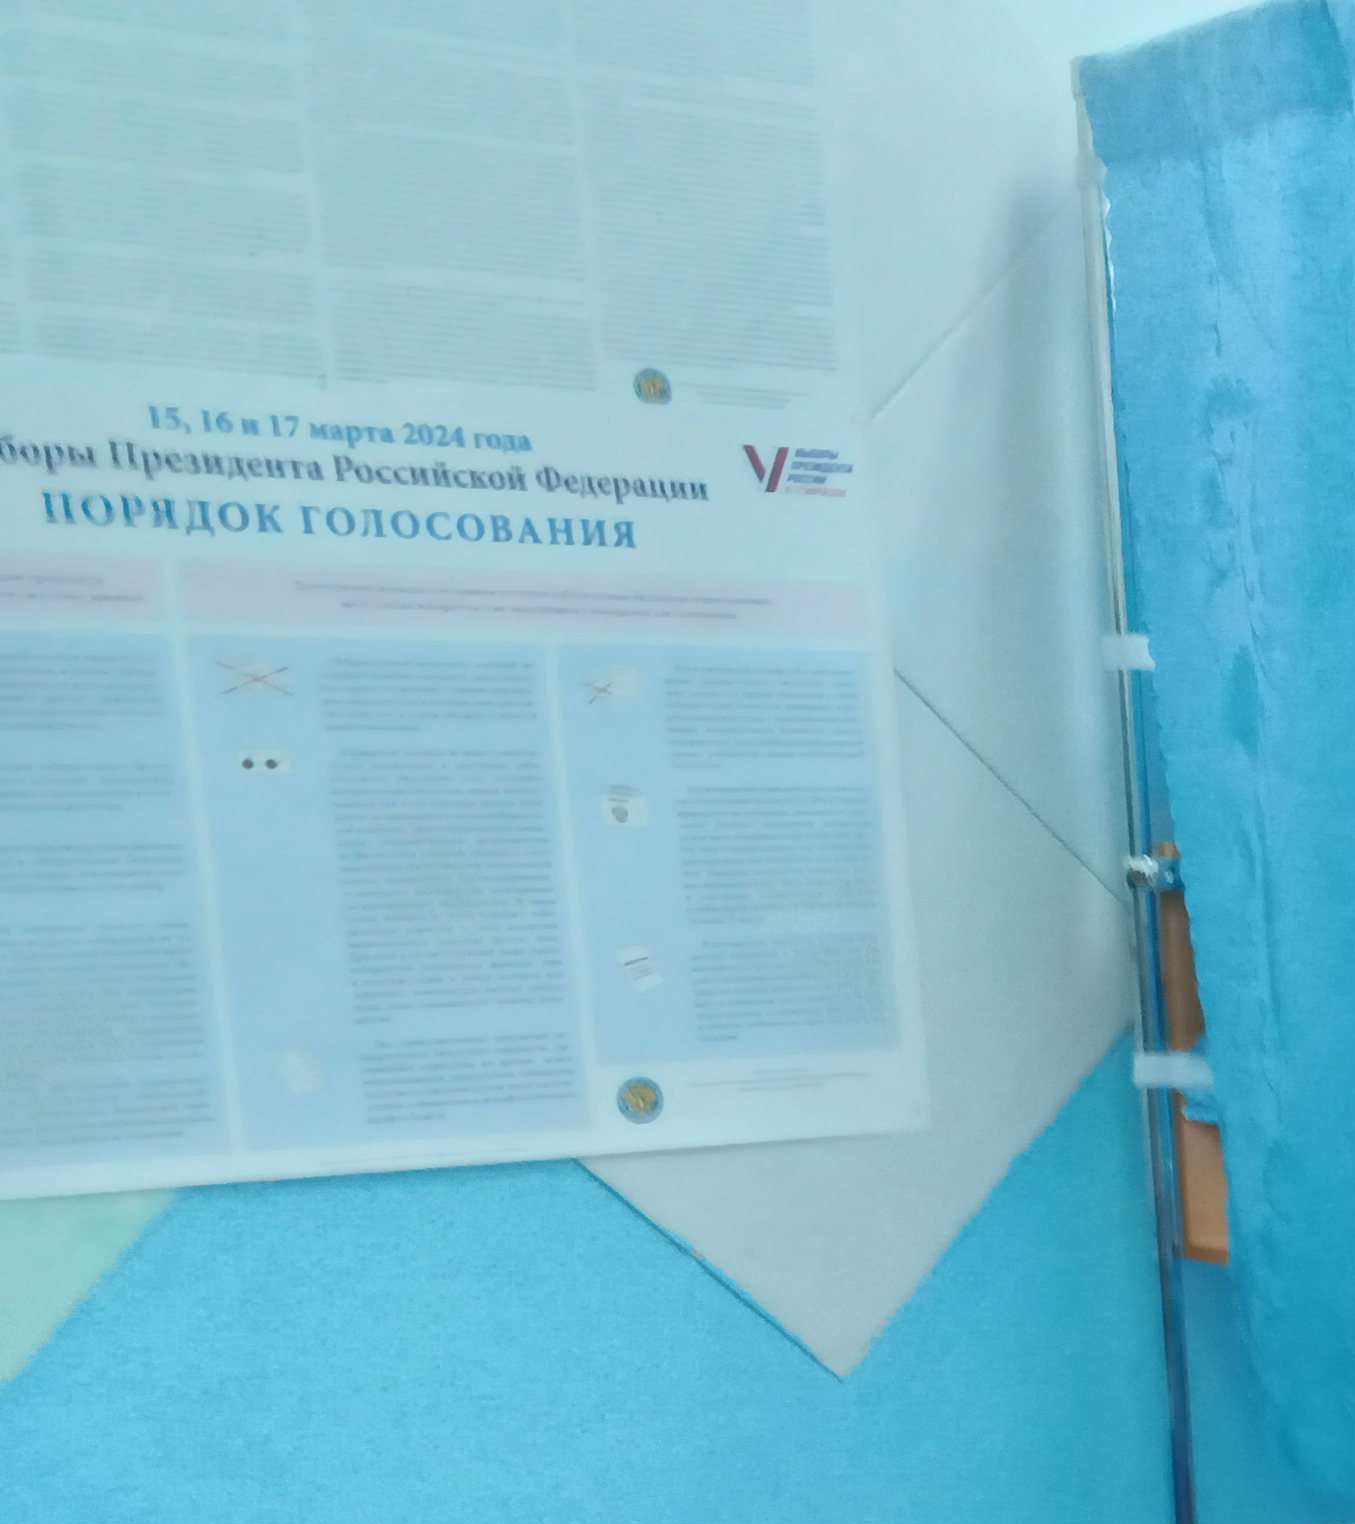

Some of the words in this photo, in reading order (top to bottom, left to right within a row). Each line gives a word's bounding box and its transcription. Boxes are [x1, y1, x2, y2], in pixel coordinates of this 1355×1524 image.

[148, 405, 192, 434] 15,
[201, 410, 234, 434] 16
[241, 418, 260, 436] и
[270, 414, 300, 437] 17
[309, 422, 395, 449] марта
[402, 422, 466, 448] 2024
[474, 429, 533, 453] года
[108, 438, 326, 481] Президента
[332, 454, 528, 491] Российской
[535, 465, 709, 504] Федерации
[42, 490, 285, 537] ПОРЯДОК
[300, 504, 637, 549] ГОЛОСОВАНИЯ
